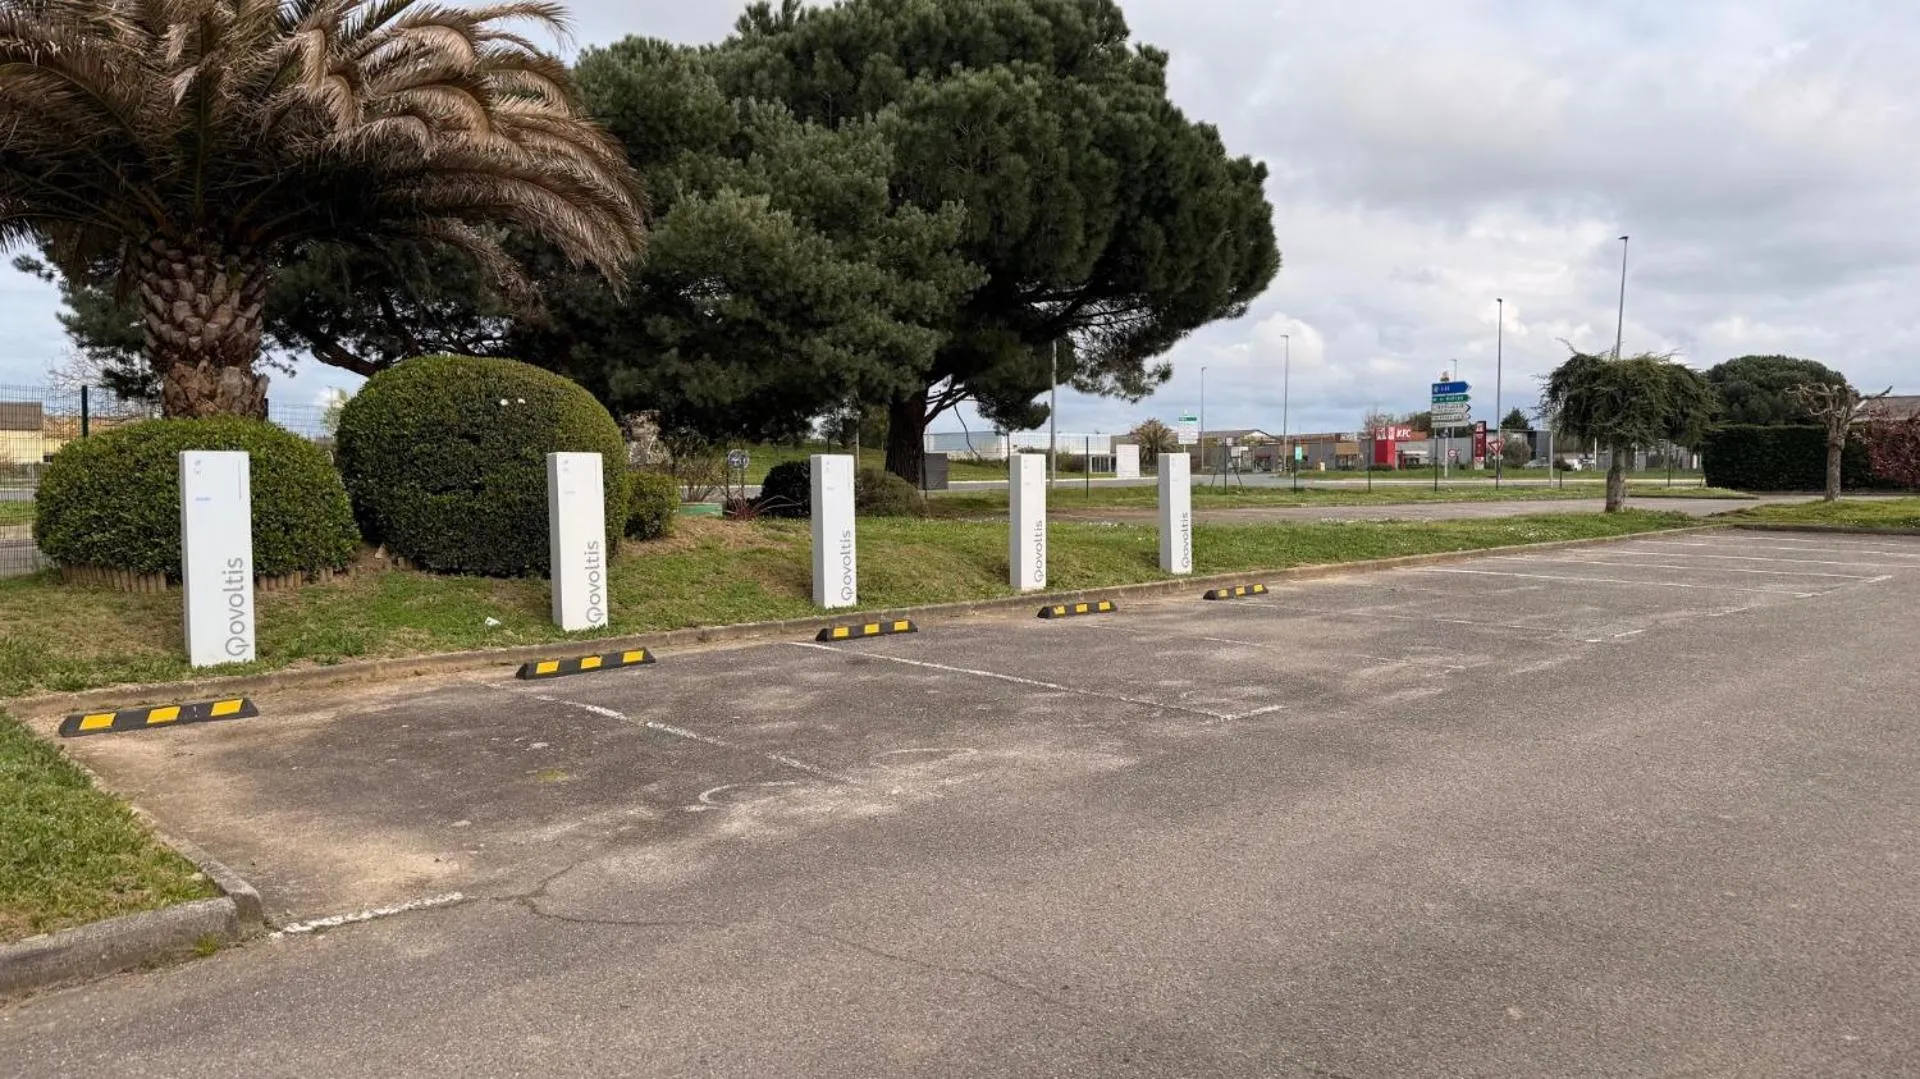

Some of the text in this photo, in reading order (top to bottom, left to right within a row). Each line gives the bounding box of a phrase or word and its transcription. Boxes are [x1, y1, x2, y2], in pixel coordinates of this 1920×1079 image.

[1396, 427, 1412, 438] KFC
[584, 540, 605, 624] Qovoltis
[839, 529, 855, 601] Qovoltis
[1033, 520, 1044, 583] Qovoltis
[222, 557, 250, 656] Qovoltis
